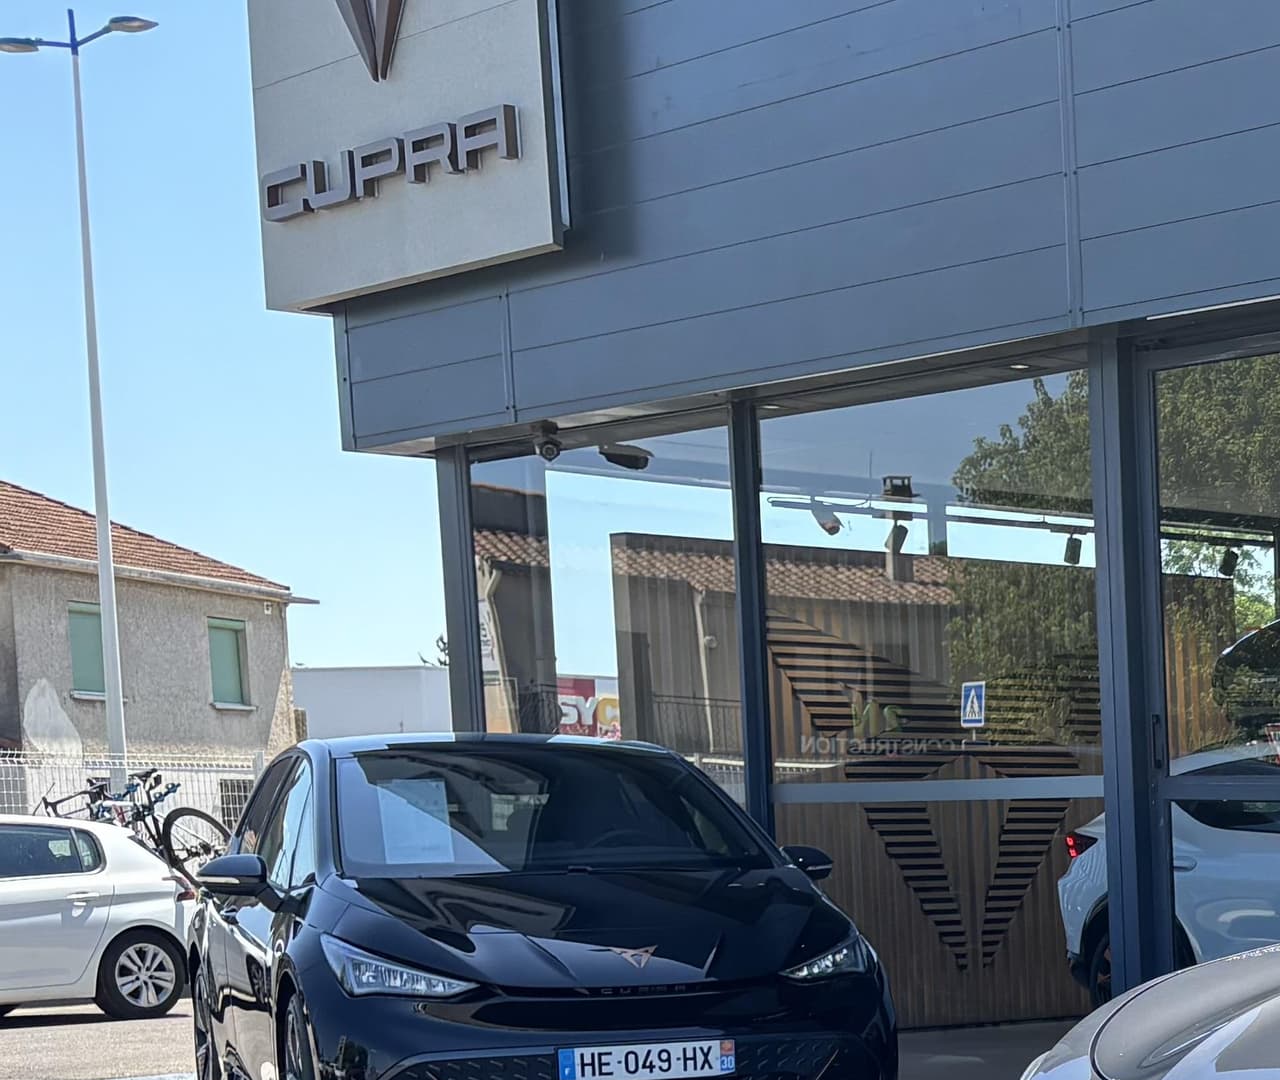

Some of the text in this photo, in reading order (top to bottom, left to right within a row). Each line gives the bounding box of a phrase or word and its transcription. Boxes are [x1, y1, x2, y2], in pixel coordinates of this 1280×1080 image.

[262, 104, 523, 222] CUPRA
[580, 1046, 714, 1077] HE-049-HX
[720, 1055, 734, 1069] 30
